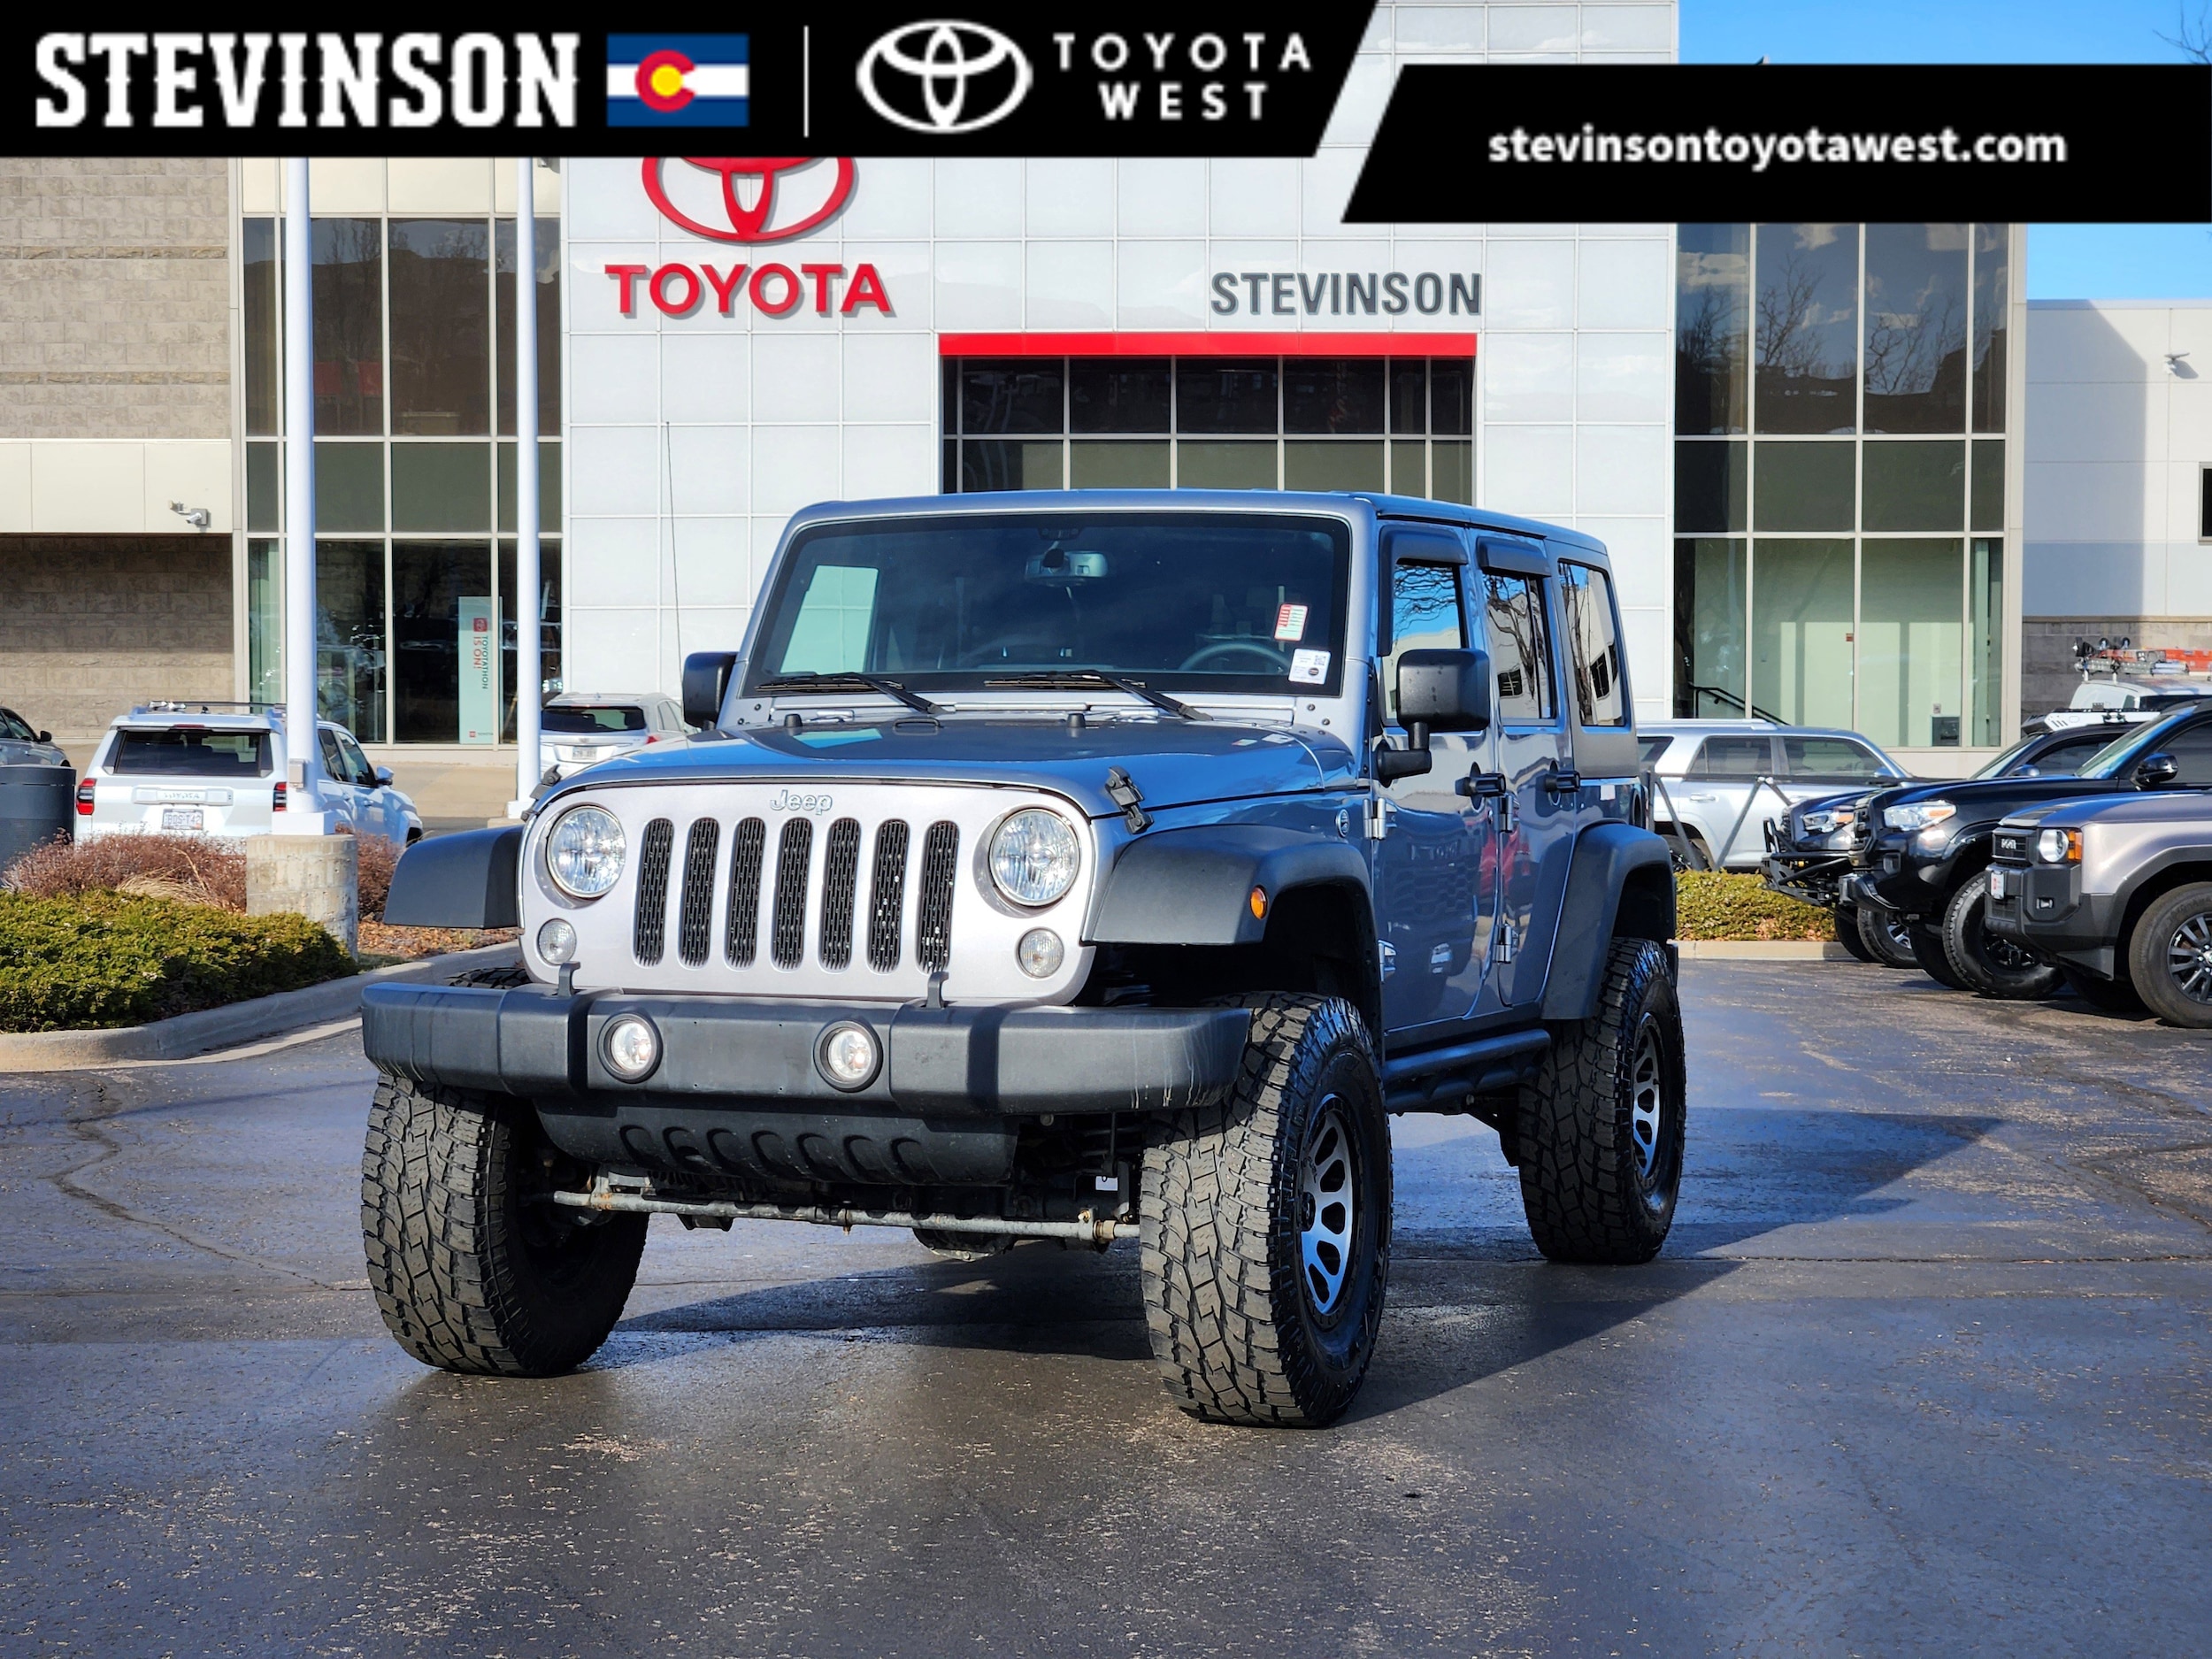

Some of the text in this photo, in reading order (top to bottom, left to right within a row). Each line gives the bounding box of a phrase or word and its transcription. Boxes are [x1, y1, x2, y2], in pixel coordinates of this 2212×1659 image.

[604, 263, 892, 314] TOYOTA
[1210, 272, 1482, 316] STEVINSON
[473, 636, 482, 646] IS
[770, 789, 833, 816] Jeep
